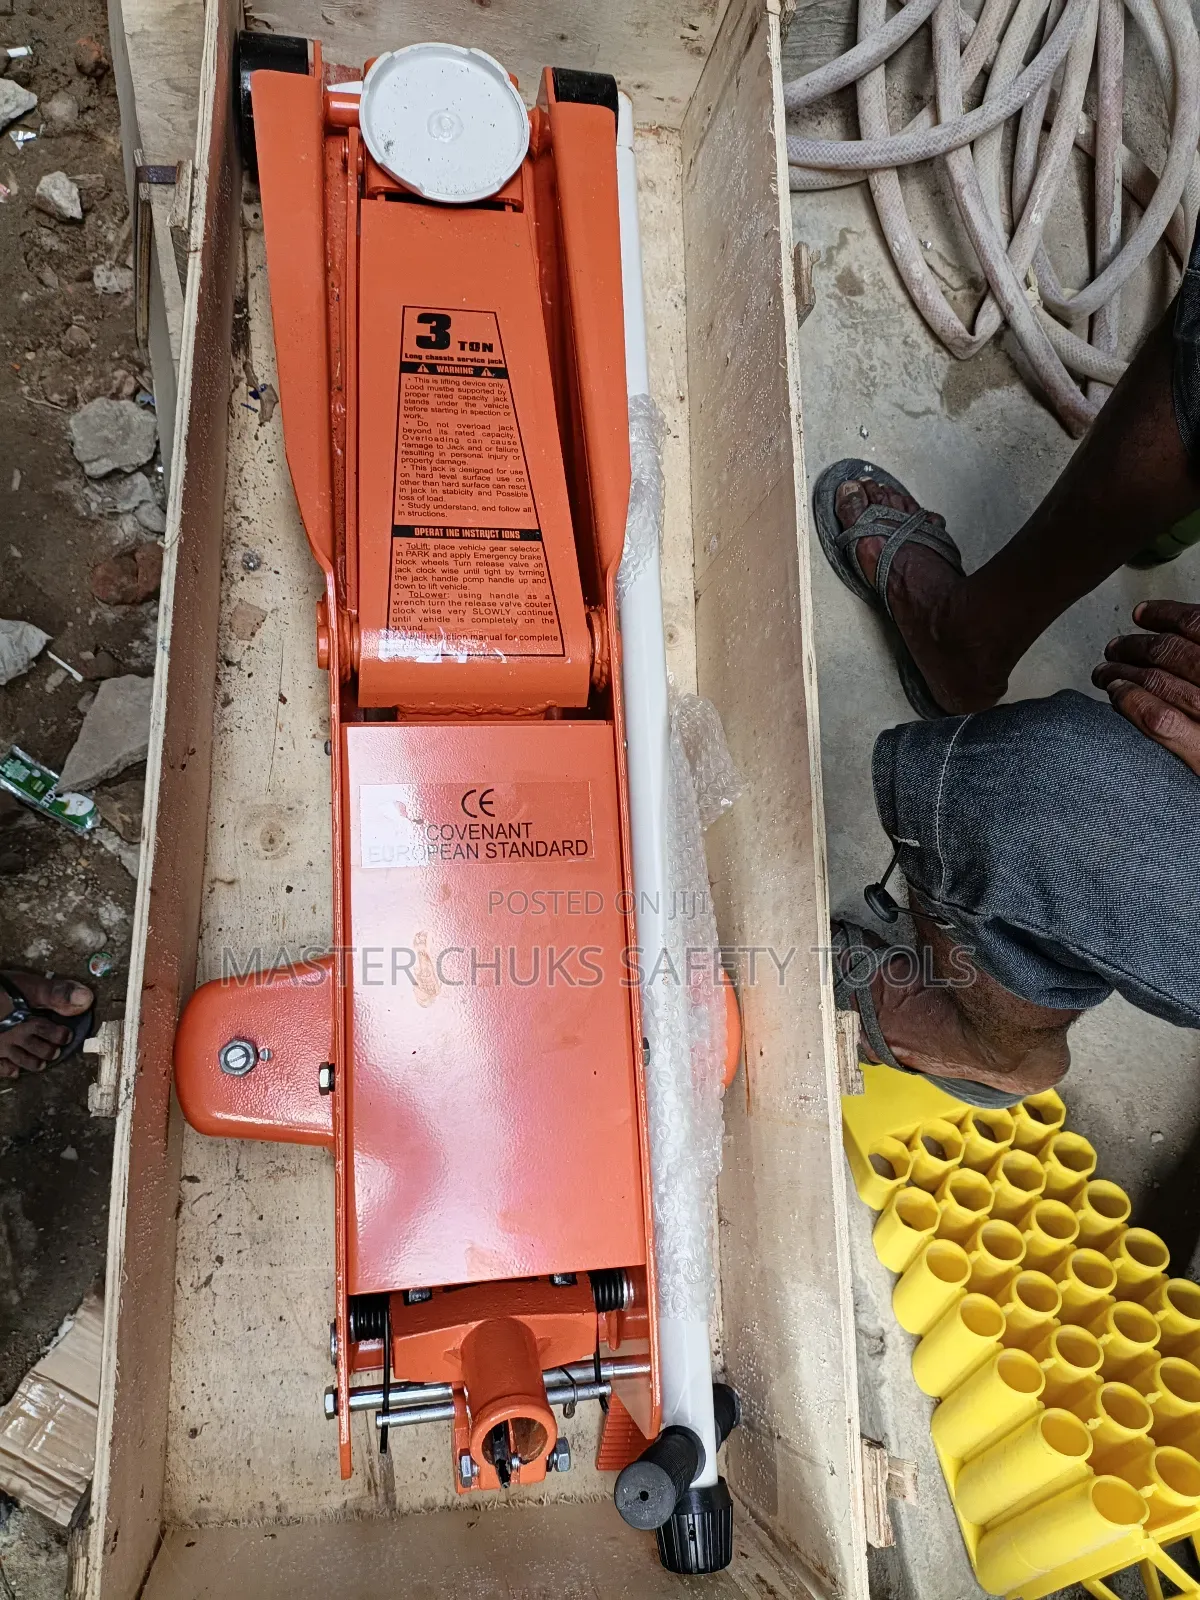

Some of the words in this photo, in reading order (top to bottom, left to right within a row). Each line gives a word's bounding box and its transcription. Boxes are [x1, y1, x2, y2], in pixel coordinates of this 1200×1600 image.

[416, 313, 451, 350] 3
[458, 341, 494, 353] TON
[436, 365, 474, 374] WARNING
[440, 378, 460, 386] lifting
[457, 386, 494, 394] supported
[457, 393, 488, 401] capacity
[402, 427, 431, 435] beyond
[401, 434, 459, 443] Overloading
[400, 456, 433, 464] property
[410, 486, 426, 494] jack
[407, 502, 430, 510] Study
[433, 543, 455, 551] place
[449, 551, 470, 559] apply
[394, 566, 411, 574] jack
[504, 568, 514, 576] by
[411, 574, 427, 582] jack
[457, 591, 482, 599] using
[471, 616, 518, 625] completely
[461, 788, 495, 818] CE
[426, 822, 533, 841] COVENANT
[368, 843, 479, 863] EUROPEAN
[485, 839, 588, 859] STANDARD
